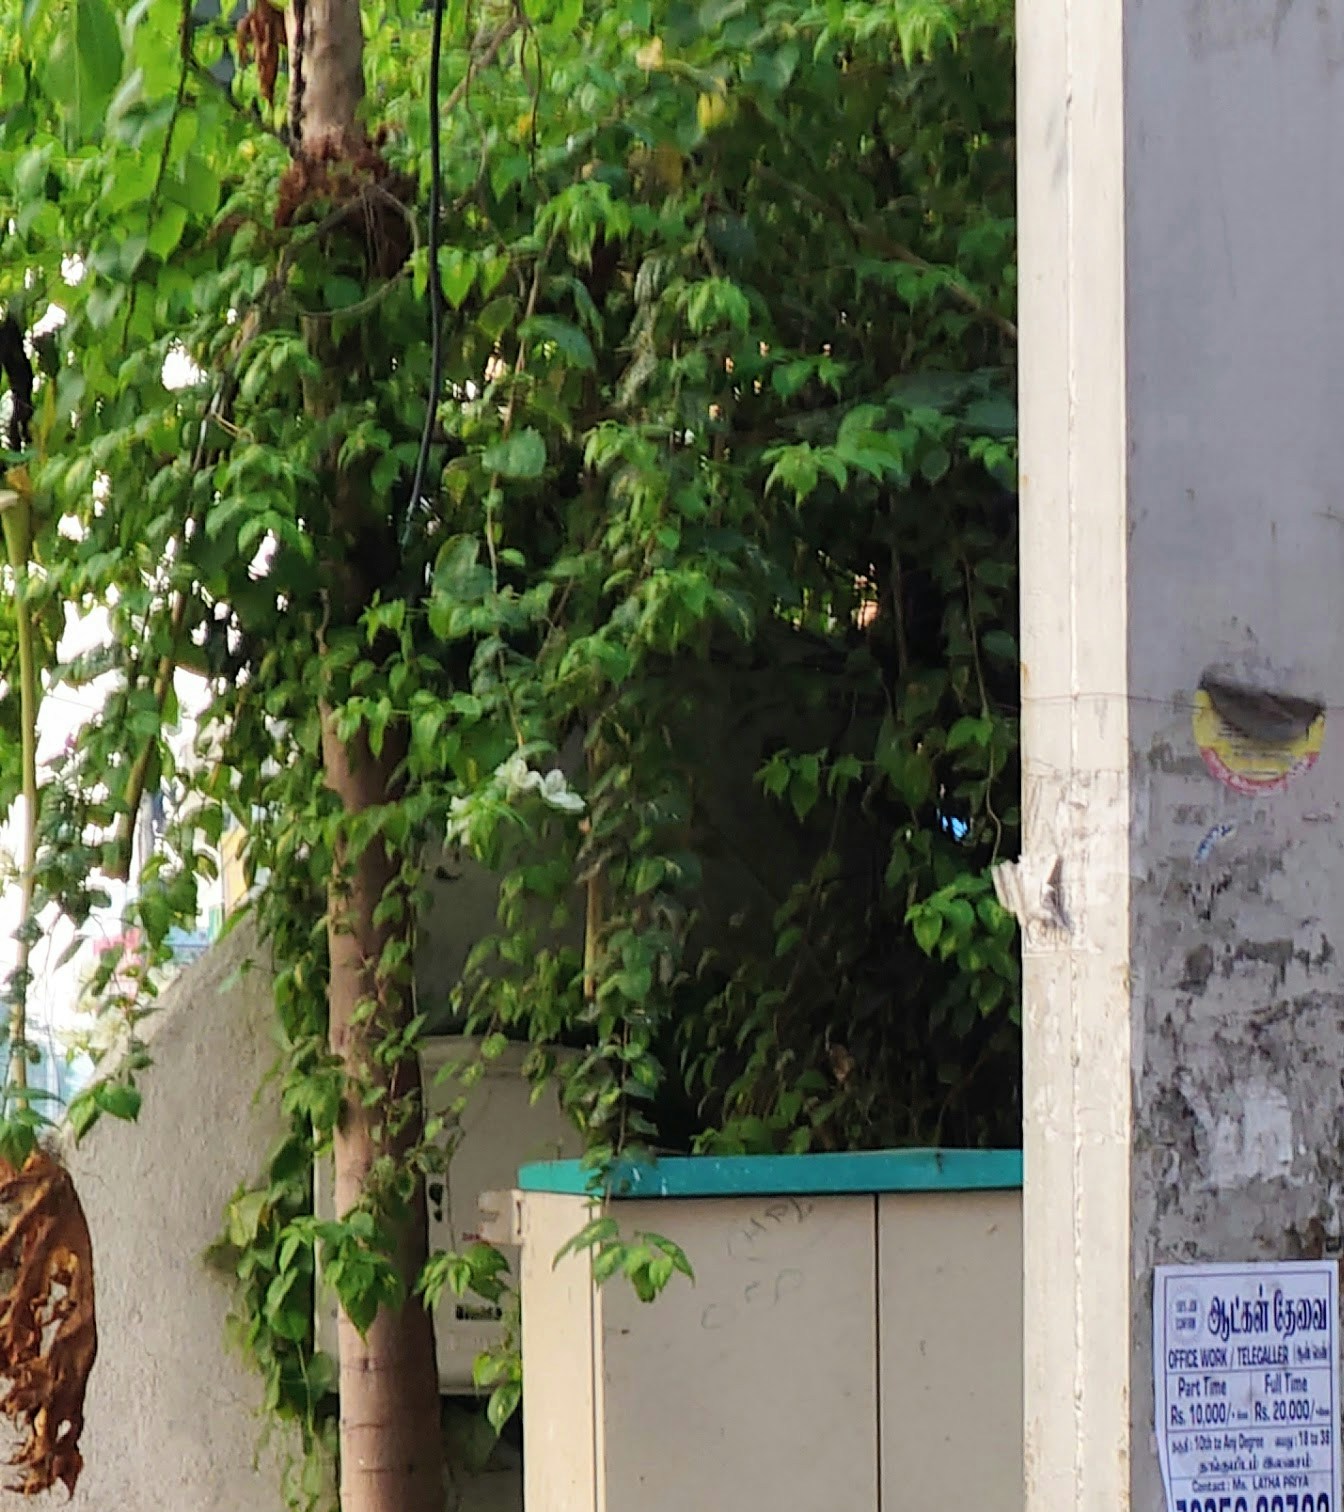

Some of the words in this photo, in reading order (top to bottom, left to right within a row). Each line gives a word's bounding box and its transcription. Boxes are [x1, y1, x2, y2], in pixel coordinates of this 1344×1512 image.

[1273, 1289, 1327, 1340] தேவை
[1169, 1347, 1198, 1369] OFFICE
[1201, 1346, 1228, 1368] WORK
[1178, 1377, 1200, 1398] Part
[1204, 1376, 1227, 1396] Time
[1265, 1373, 1281, 1394] Full
[1285, 1372, 1308, 1393] Time
